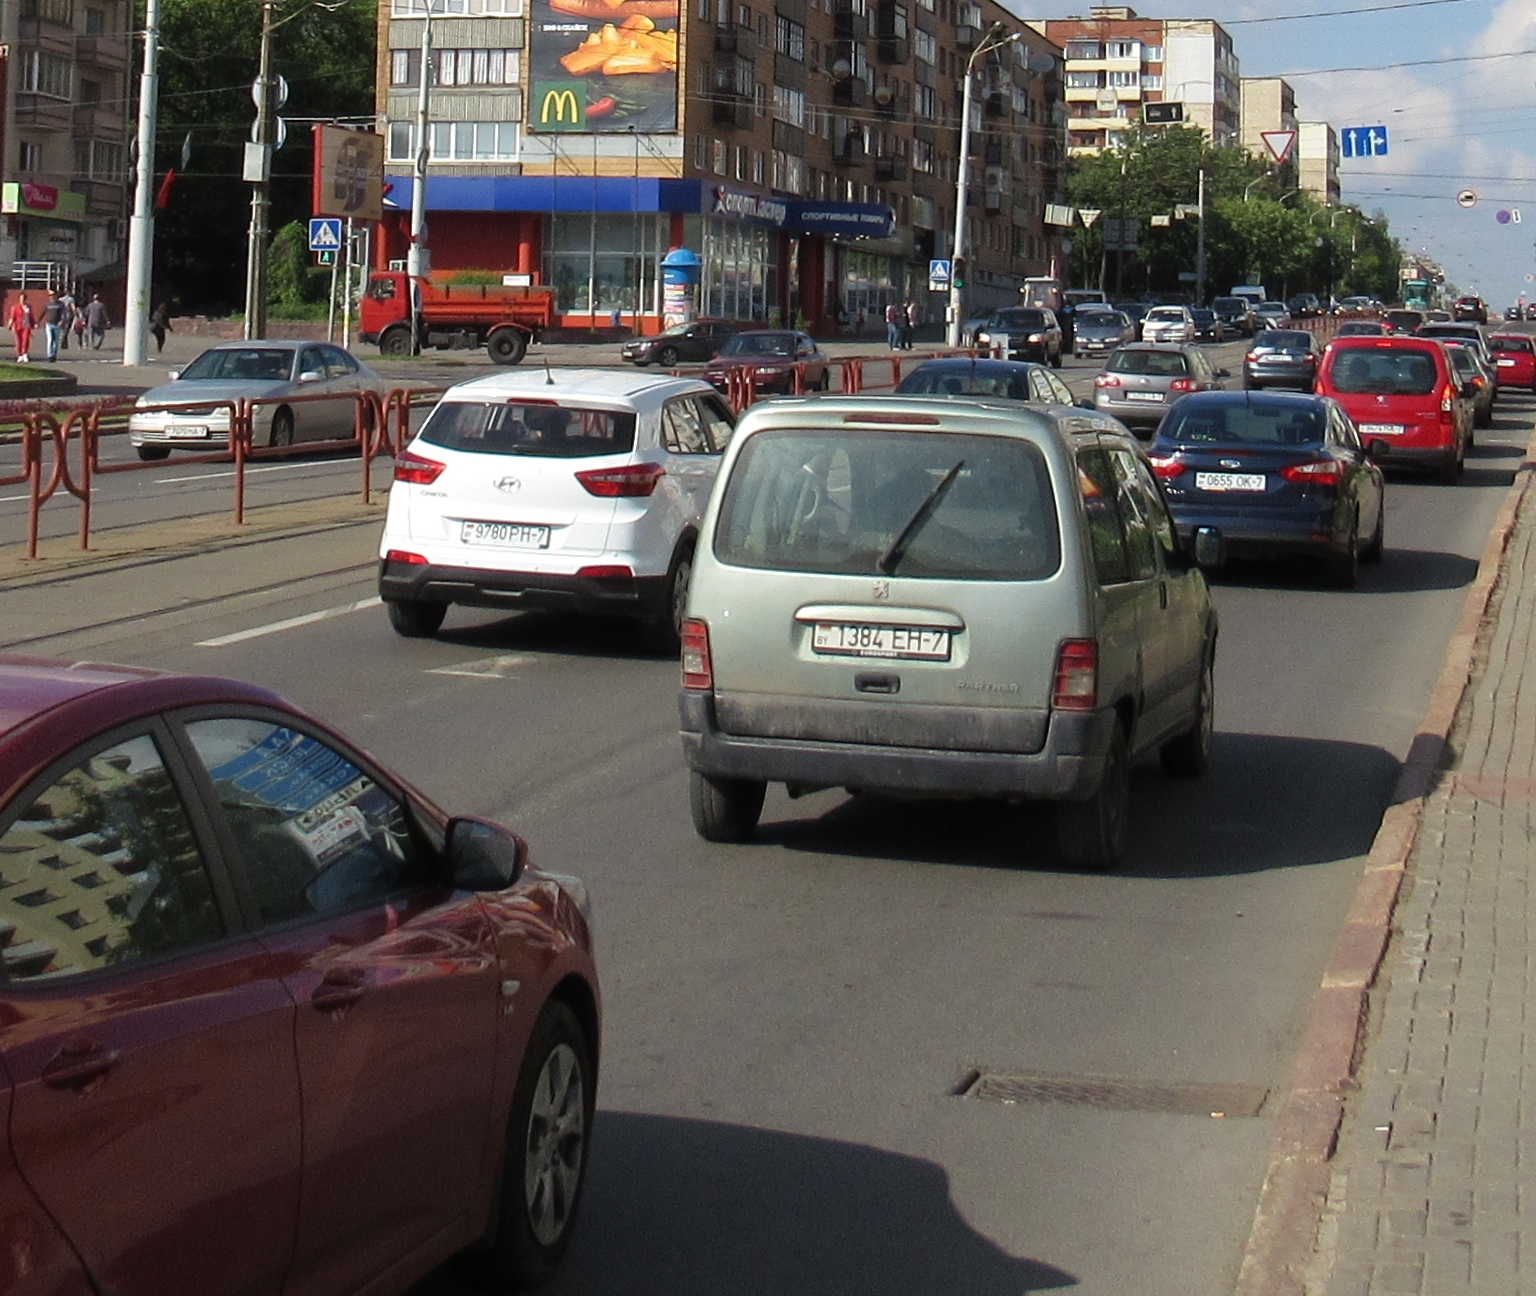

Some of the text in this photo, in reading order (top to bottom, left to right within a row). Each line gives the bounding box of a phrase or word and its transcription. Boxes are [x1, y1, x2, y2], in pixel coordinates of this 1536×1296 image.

[1206, 474, 1233, 486] 0655
[837, 625, 884, 649] 1384
[957, 680, 1021, 694] PARTNER
